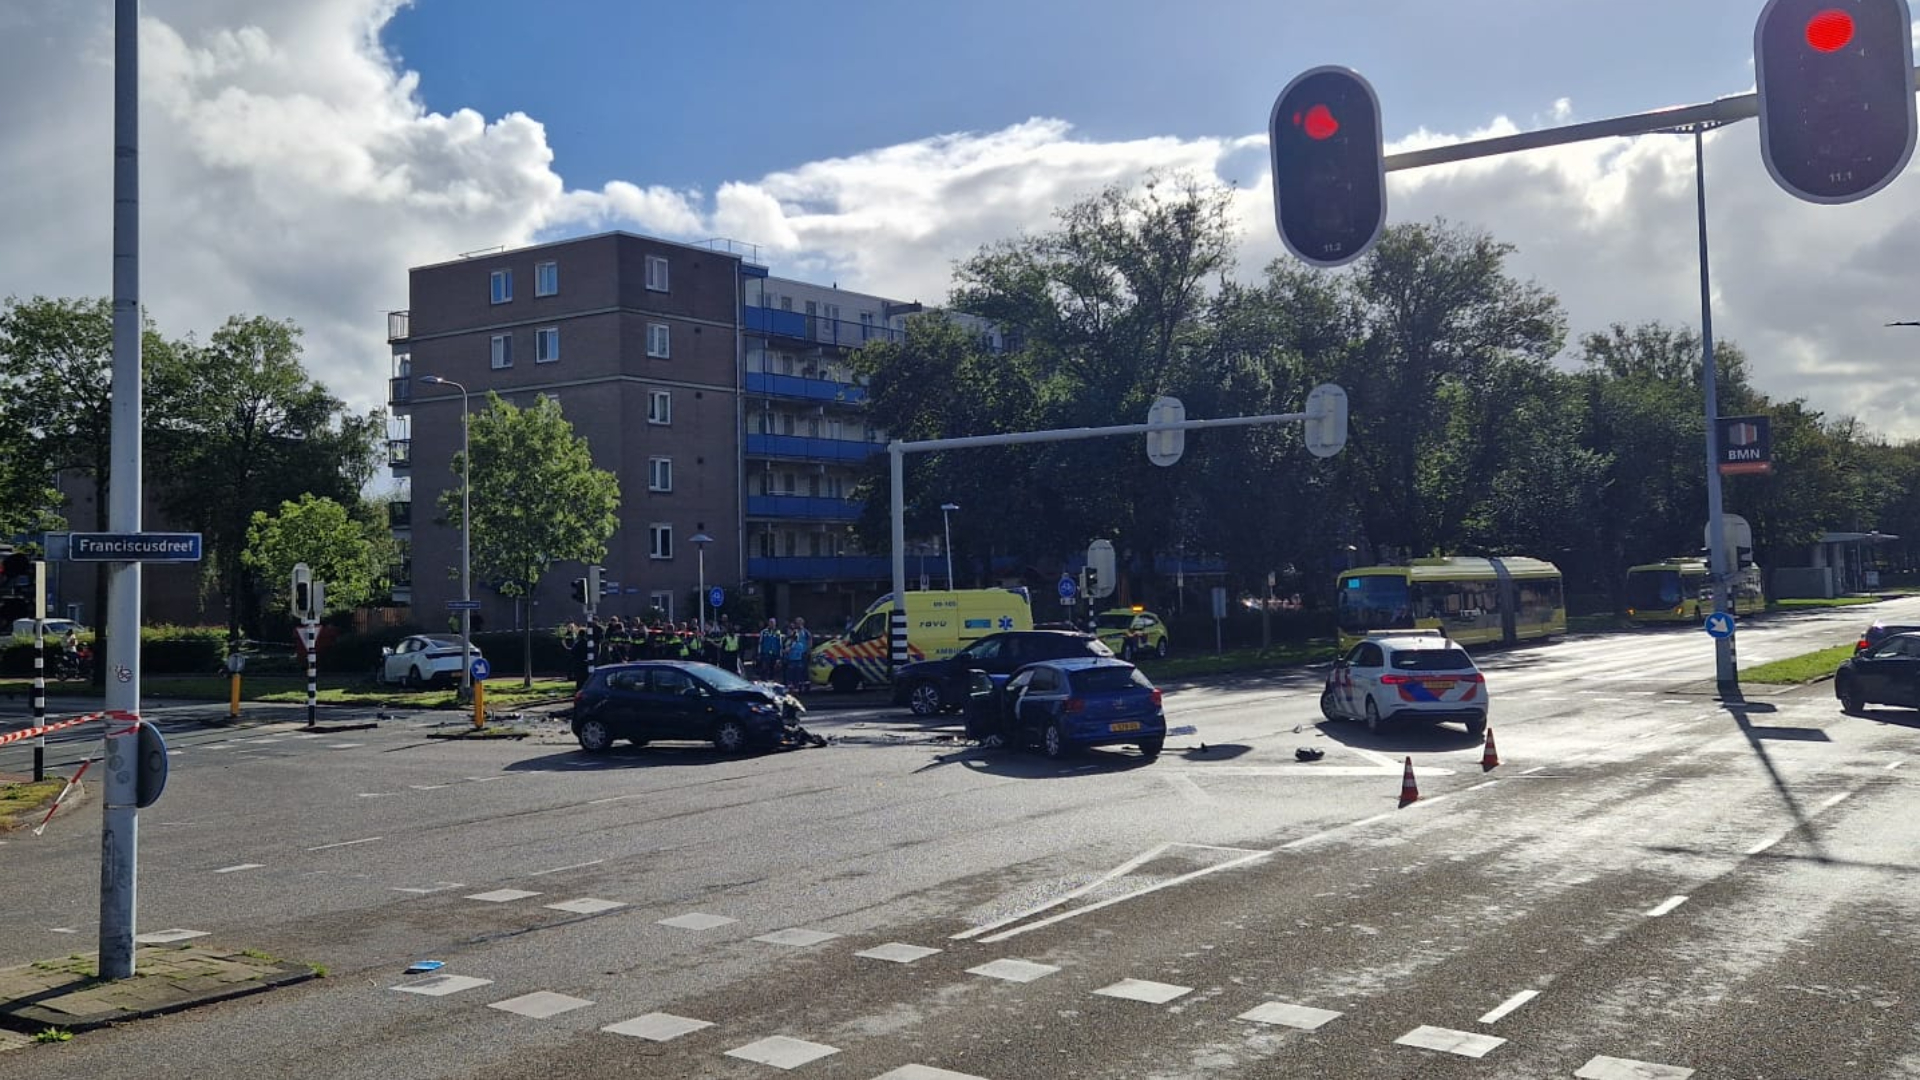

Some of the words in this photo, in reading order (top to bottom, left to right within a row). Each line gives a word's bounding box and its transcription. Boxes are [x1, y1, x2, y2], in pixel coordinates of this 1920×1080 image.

[1829, 171, 1851, 182] 11.1
[1728, 449, 1760, 460] BMN
[80, 539, 193, 552] Franciscusdreef
